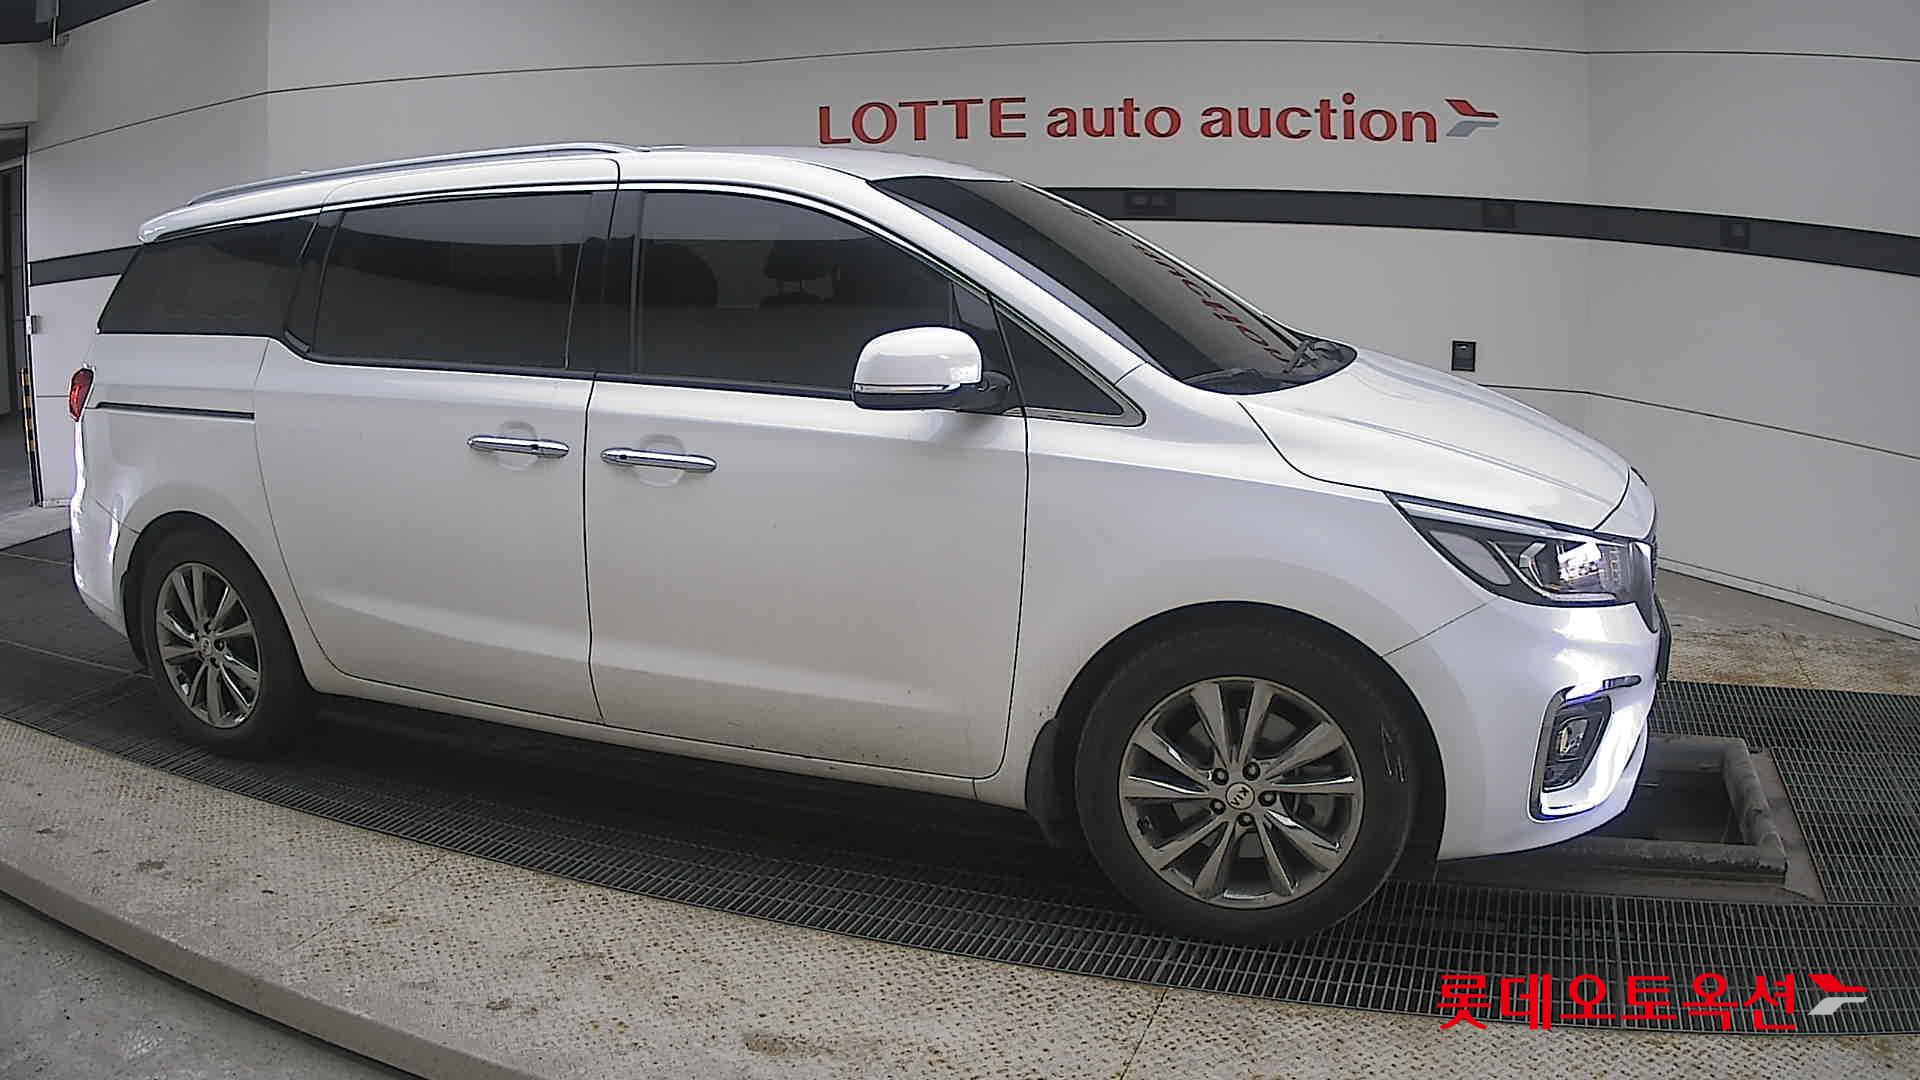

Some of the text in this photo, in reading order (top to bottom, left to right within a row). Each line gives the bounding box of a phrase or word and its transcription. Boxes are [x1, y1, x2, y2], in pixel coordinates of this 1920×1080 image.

[819, 93, 1437, 144] LOTTE auto auction
